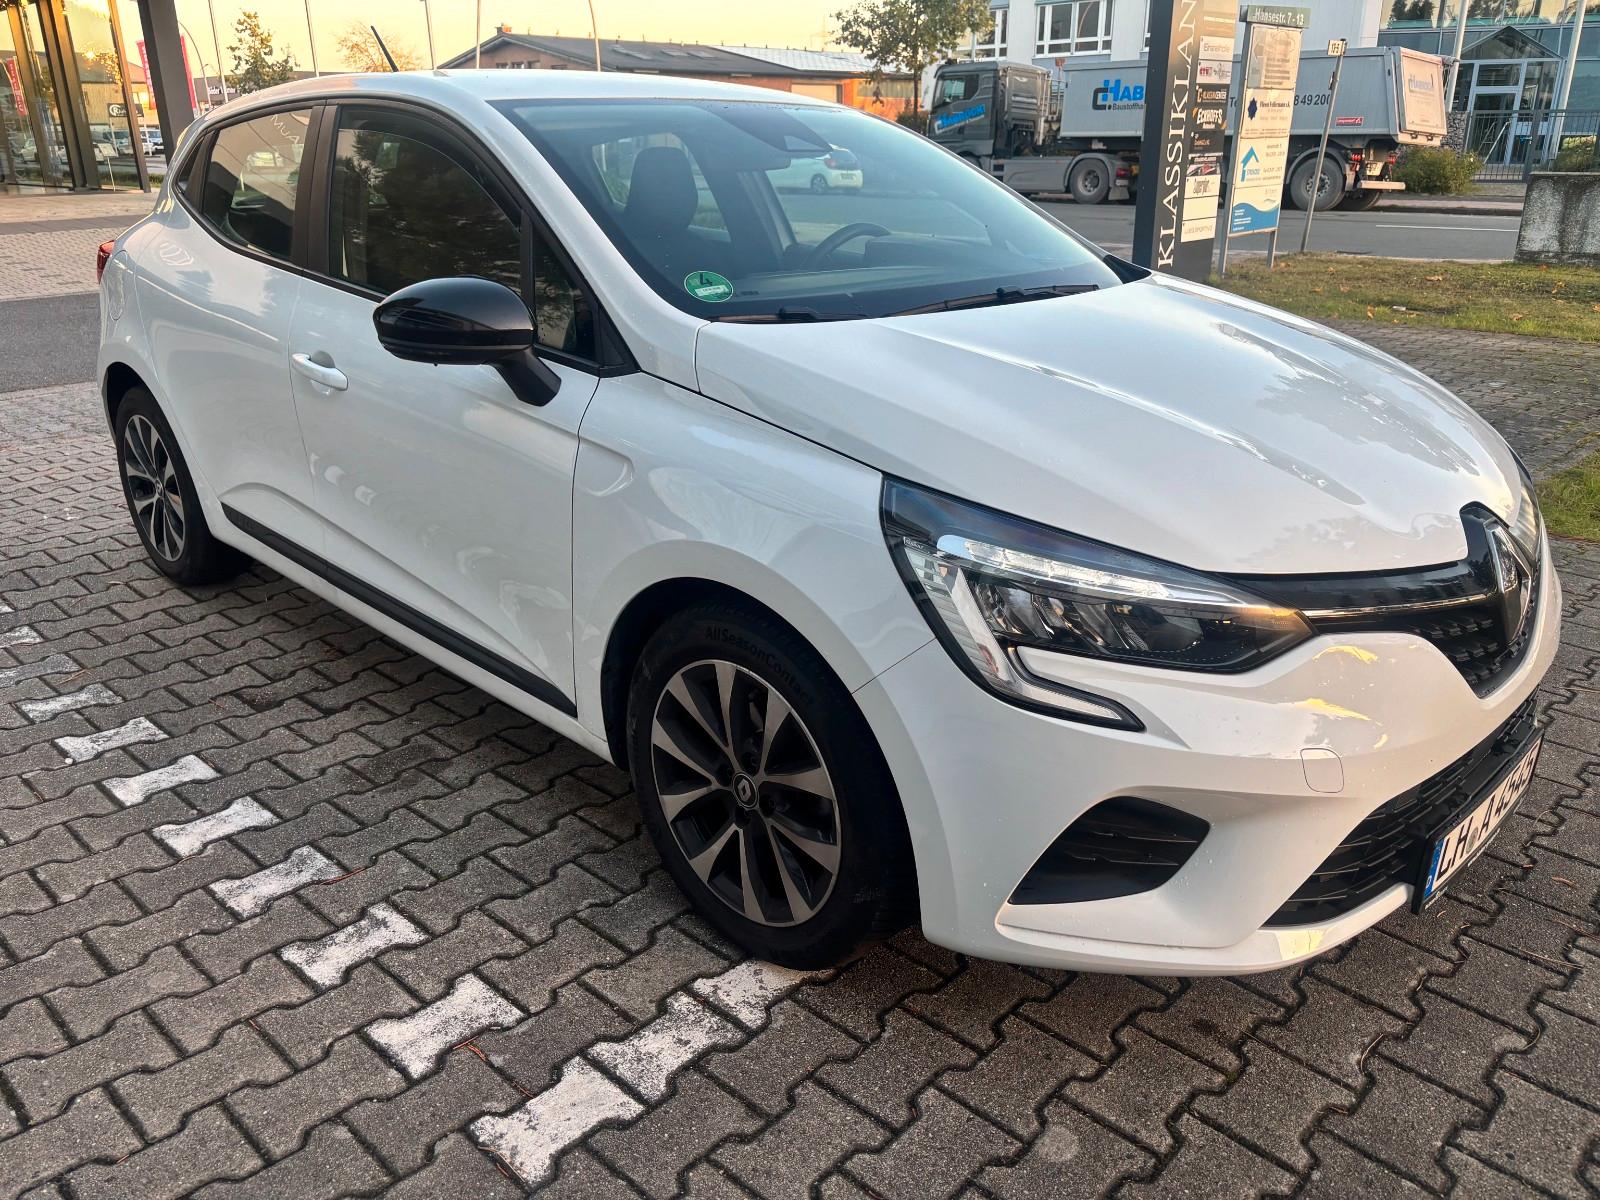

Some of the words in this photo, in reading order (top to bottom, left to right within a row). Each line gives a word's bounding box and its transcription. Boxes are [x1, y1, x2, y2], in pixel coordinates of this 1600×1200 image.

[1255, 8, 1286, 23] Hansestr.
[1287, 12, 1292, 24] 7
[1296, 13, 1304, 26] 13
[1102, 79, 1144, 101] HAB
[1301, 95, 1312, 107] 49
[704, 626, 814, 705] AllSeasonContac
[1436, 816, 1474, 882] LH
